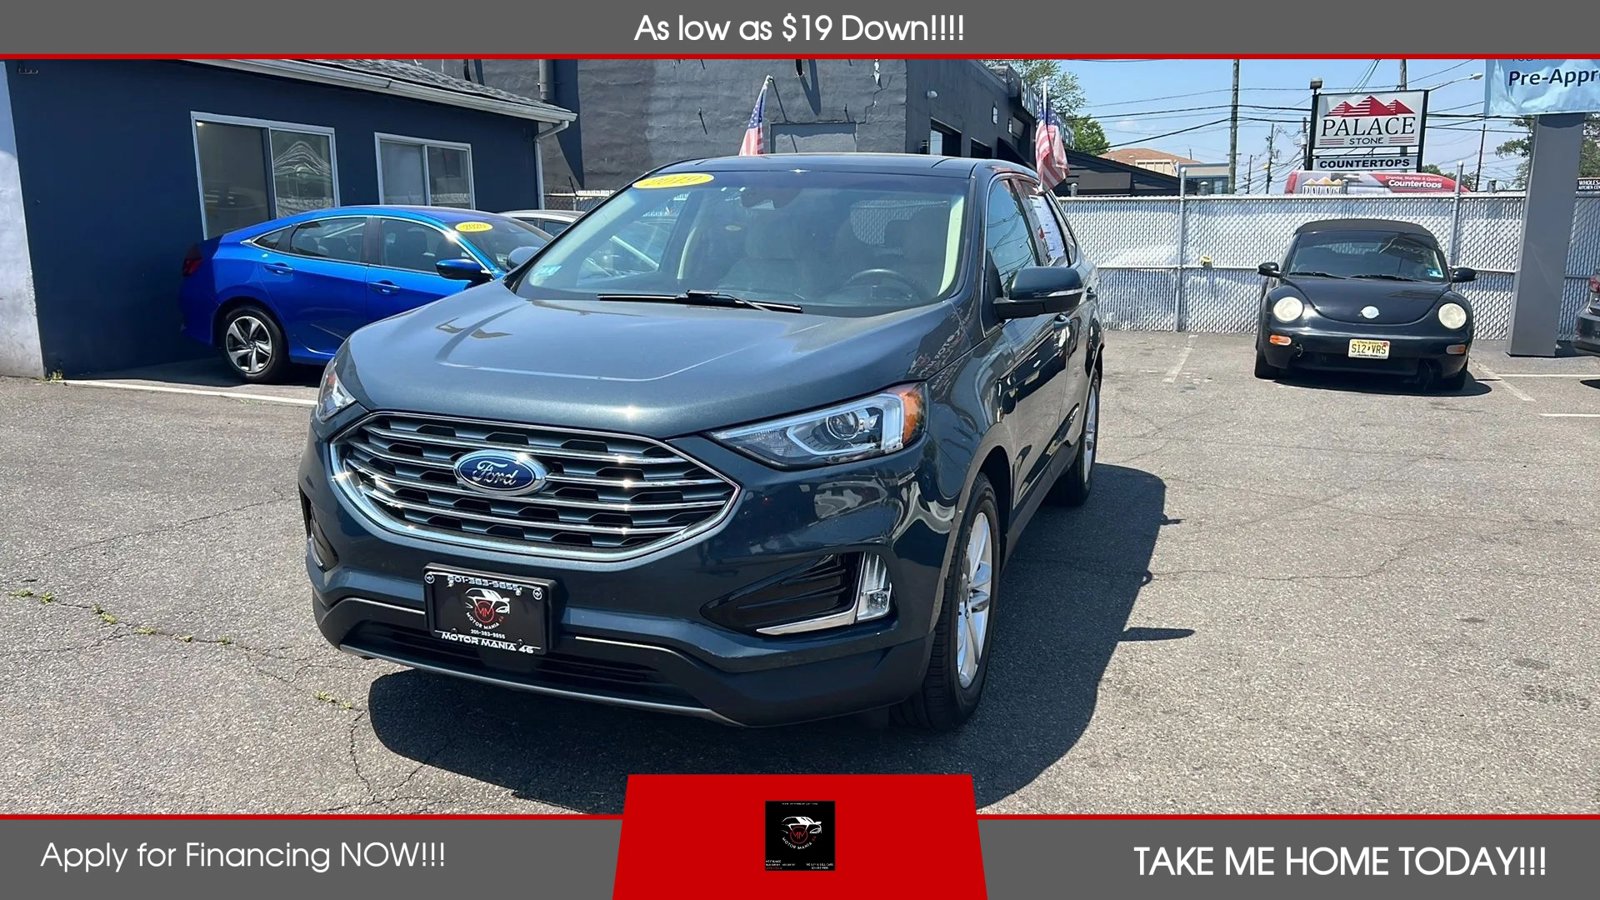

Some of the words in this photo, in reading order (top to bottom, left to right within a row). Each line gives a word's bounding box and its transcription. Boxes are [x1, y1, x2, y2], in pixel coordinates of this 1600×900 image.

[1508, 68, 1600, 88] Pre-Appr
[1321, 116, 1416, 137] PALACE
[1348, 137, 1384, 145] STONE
[1319, 158, 1410, 169] COUNTERTOPS
[1388, 180, 1442, 188] Countertops
[472, 460, 519, 486] Ford
[466, 612, 483, 628] MOTOR
[483, 622, 500, 630] MANIA
[441, 631, 480, 645] MOTOR
[480, 637, 517, 652] MANIA
[518, 644, 534, 654] 46
